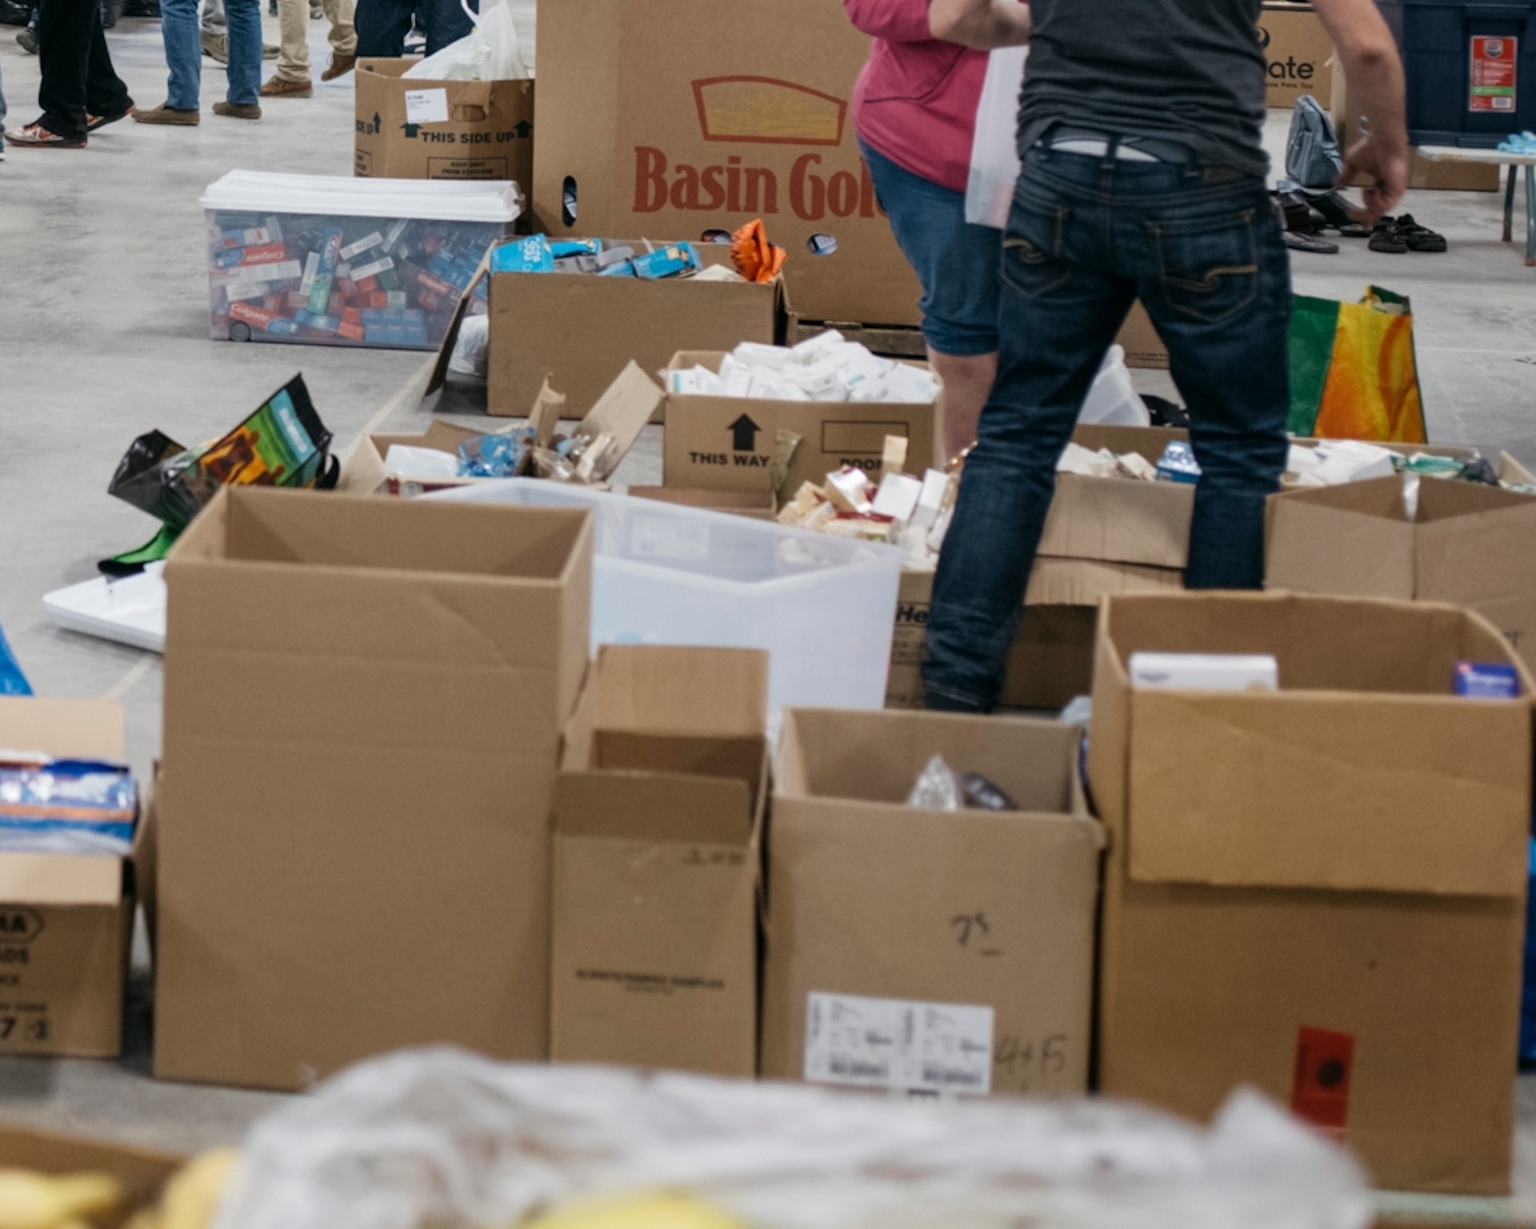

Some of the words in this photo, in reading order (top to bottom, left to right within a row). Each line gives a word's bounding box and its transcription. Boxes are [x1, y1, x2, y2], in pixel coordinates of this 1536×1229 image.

[421, 131, 456, 144] THIS
[460, 132, 493, 144] SIDE
[496, 132, 515, 144] UP
[632, 145, 779, 215] Basin
[789, 152, 888, 222] Gol
[230, 303, 270, 322] Colgate
[688, 452, 729, 466] THIS
[733, 455, 770, 468] WAY
